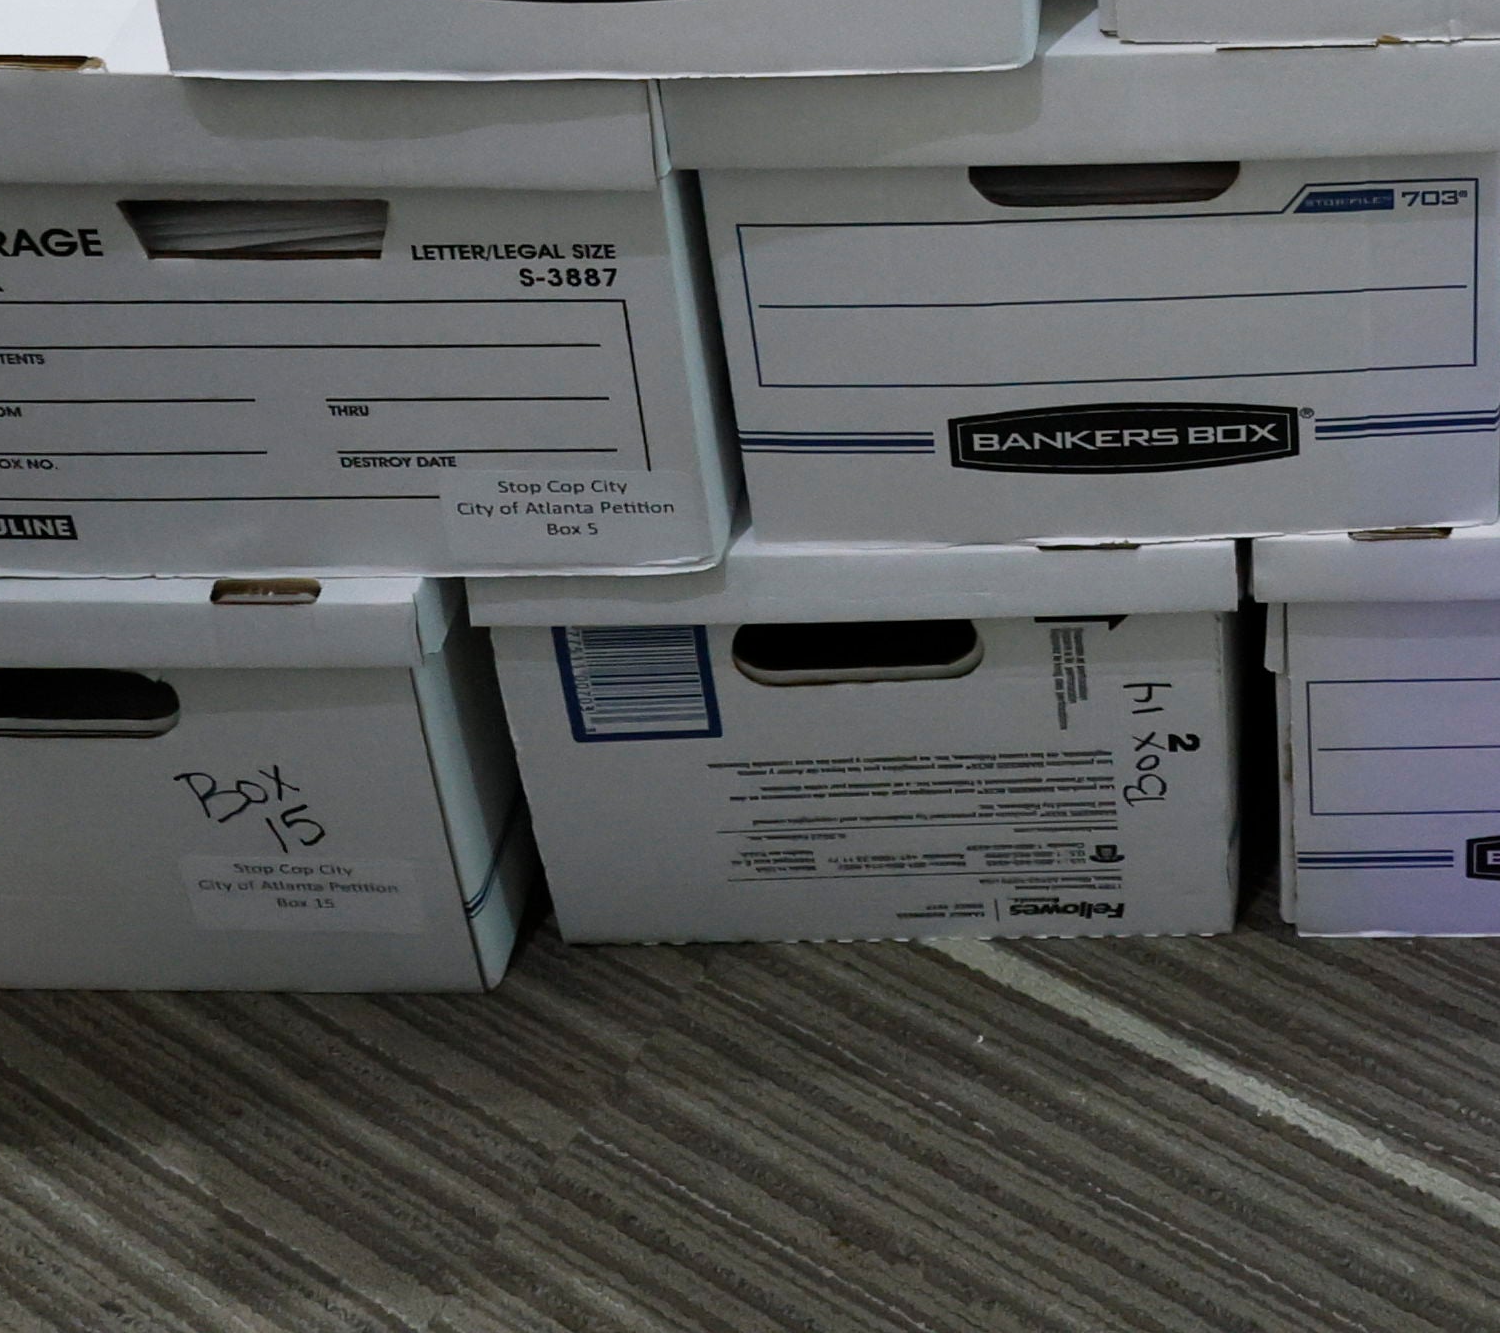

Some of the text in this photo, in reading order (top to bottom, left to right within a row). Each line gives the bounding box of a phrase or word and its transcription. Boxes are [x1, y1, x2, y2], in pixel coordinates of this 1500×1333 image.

[410, 243, 616, 261] LETTER/LEGAL SIZE
[519, 267, 617, 287] S-3887
[327, 404, 370, 417] THRU
[972, 423, 1278, 452] BANKERS BOX
[26, 458, 54, 471] NO.
[340, 455, 457, 468] DESTROY DATE
[497, 479, 628, 495] Stop Cop City
[456, 501, 675, 518] City of Atlanta Petition
[546, 522, 599, 536] Box 5
[1122, 682, 1172, 715] 14
[1167, 733, 1201, 753] 2
[261, 801, 326, 854] 15
[1009, 902, 1125, 919] Fellowes
